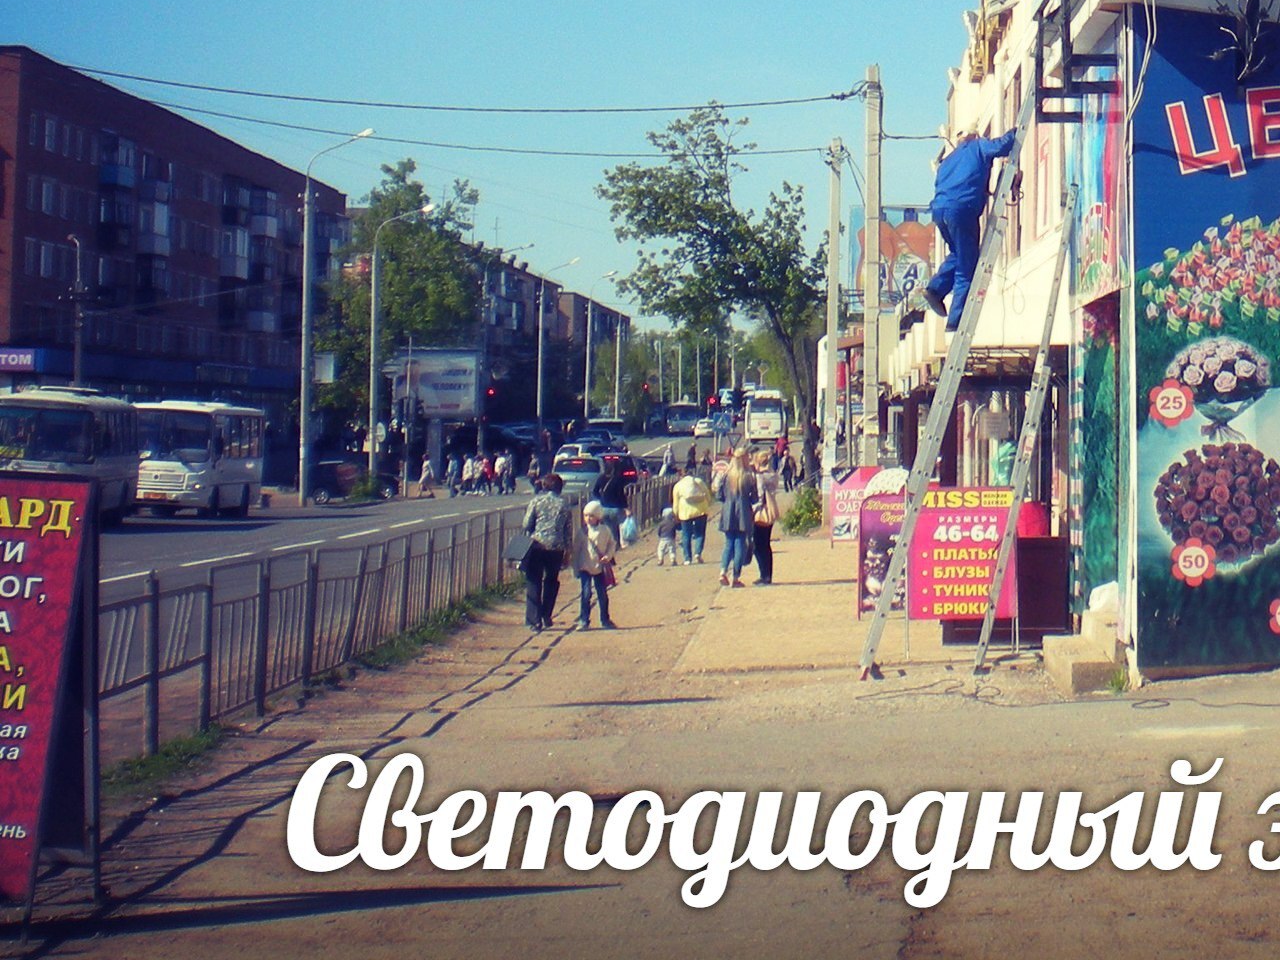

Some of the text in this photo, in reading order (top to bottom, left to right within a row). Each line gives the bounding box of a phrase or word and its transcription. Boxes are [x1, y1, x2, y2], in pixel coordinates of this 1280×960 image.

[1160, 396, 1183, 410] 25
[923, 490, 980, 508] MISS
[938, 515, 998, 523] РАЗМЕРЫ
[933, 524, 999, 542] 46-64
[933, 548, 998, 561] ПЛАТЬЯ
[1182, 555, 1206, 568] 50
[933, 566, 990, 579] БЛУЗЫ
[933, 584, 992, 597] ТУНИК
